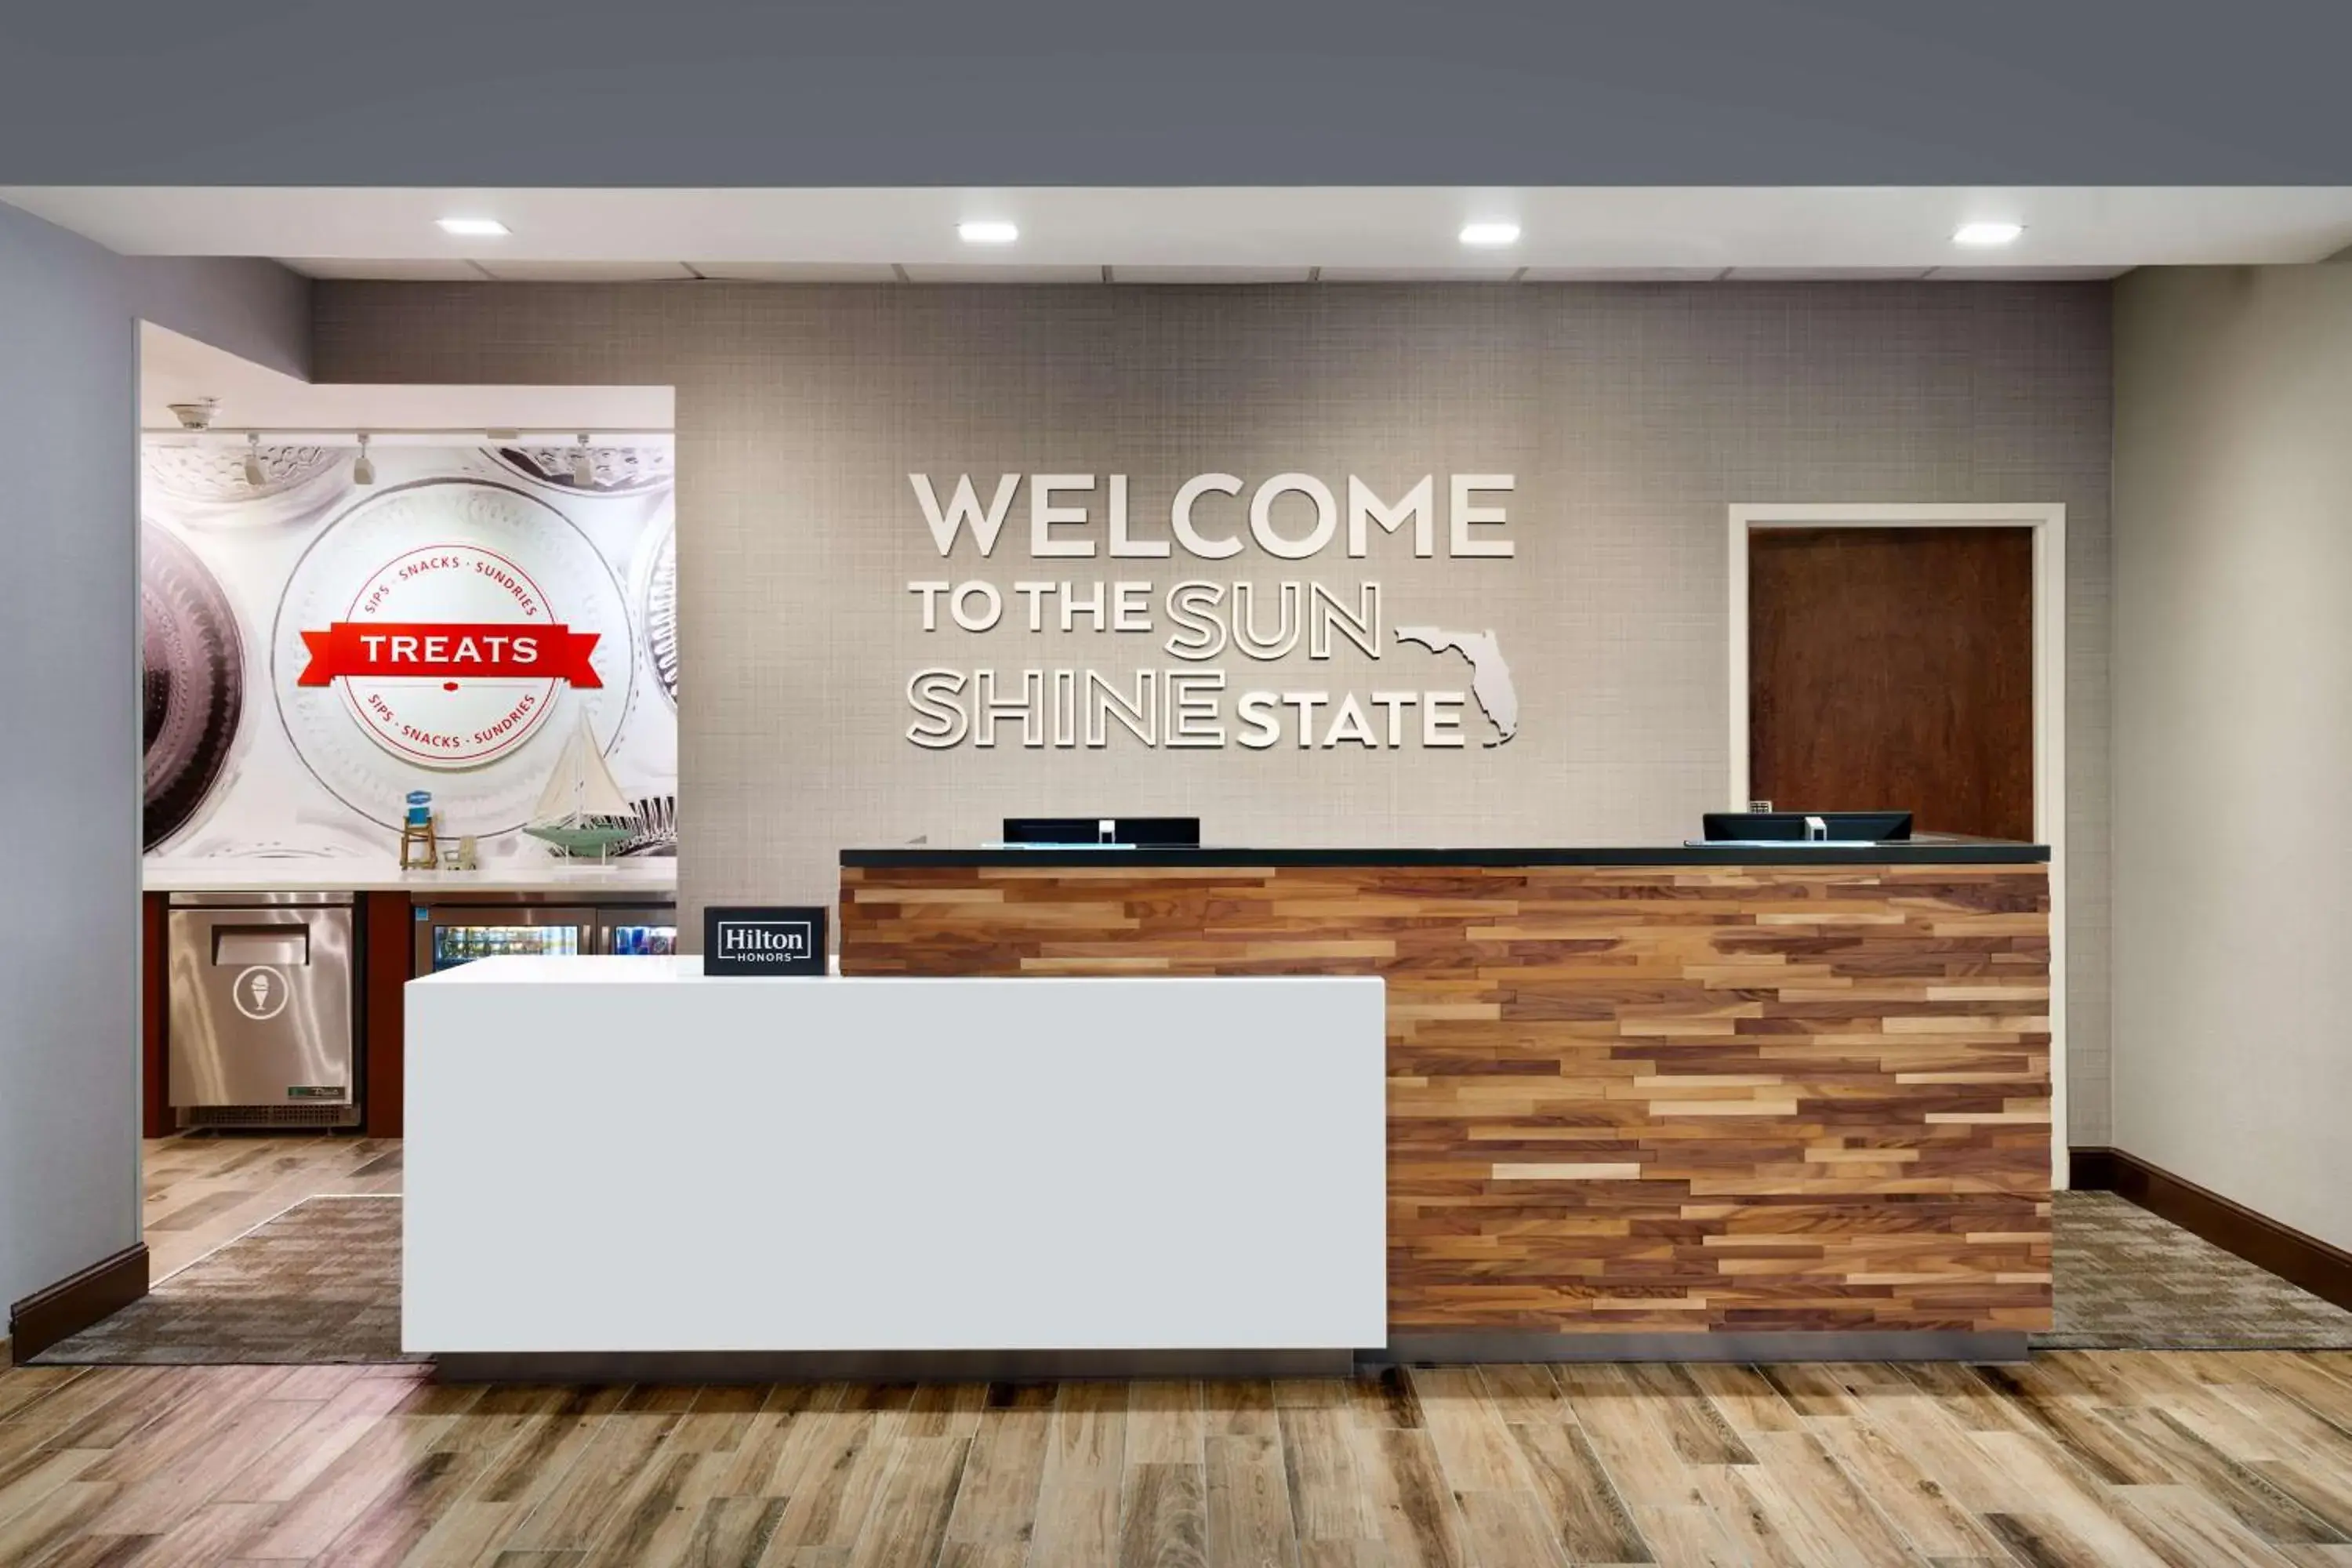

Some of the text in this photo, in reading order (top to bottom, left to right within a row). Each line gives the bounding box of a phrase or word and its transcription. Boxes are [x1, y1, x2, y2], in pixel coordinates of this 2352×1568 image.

[908, 472, 1515, 558] WELCOME
[365, 556, 537, 616] SIPS SNACKS SUNDRIES
[908, 580, 1381, 660] TO THE SUN
[360, 636, 539, 663] TREATS
[368, 694, 535, 748] SIPS SNACKS SUNDRIES
[906, 668, 1465, 749] SHINE STATE
[726, 929, 803, 949] Hilton
[737, 953, 792, 962] HONORS
